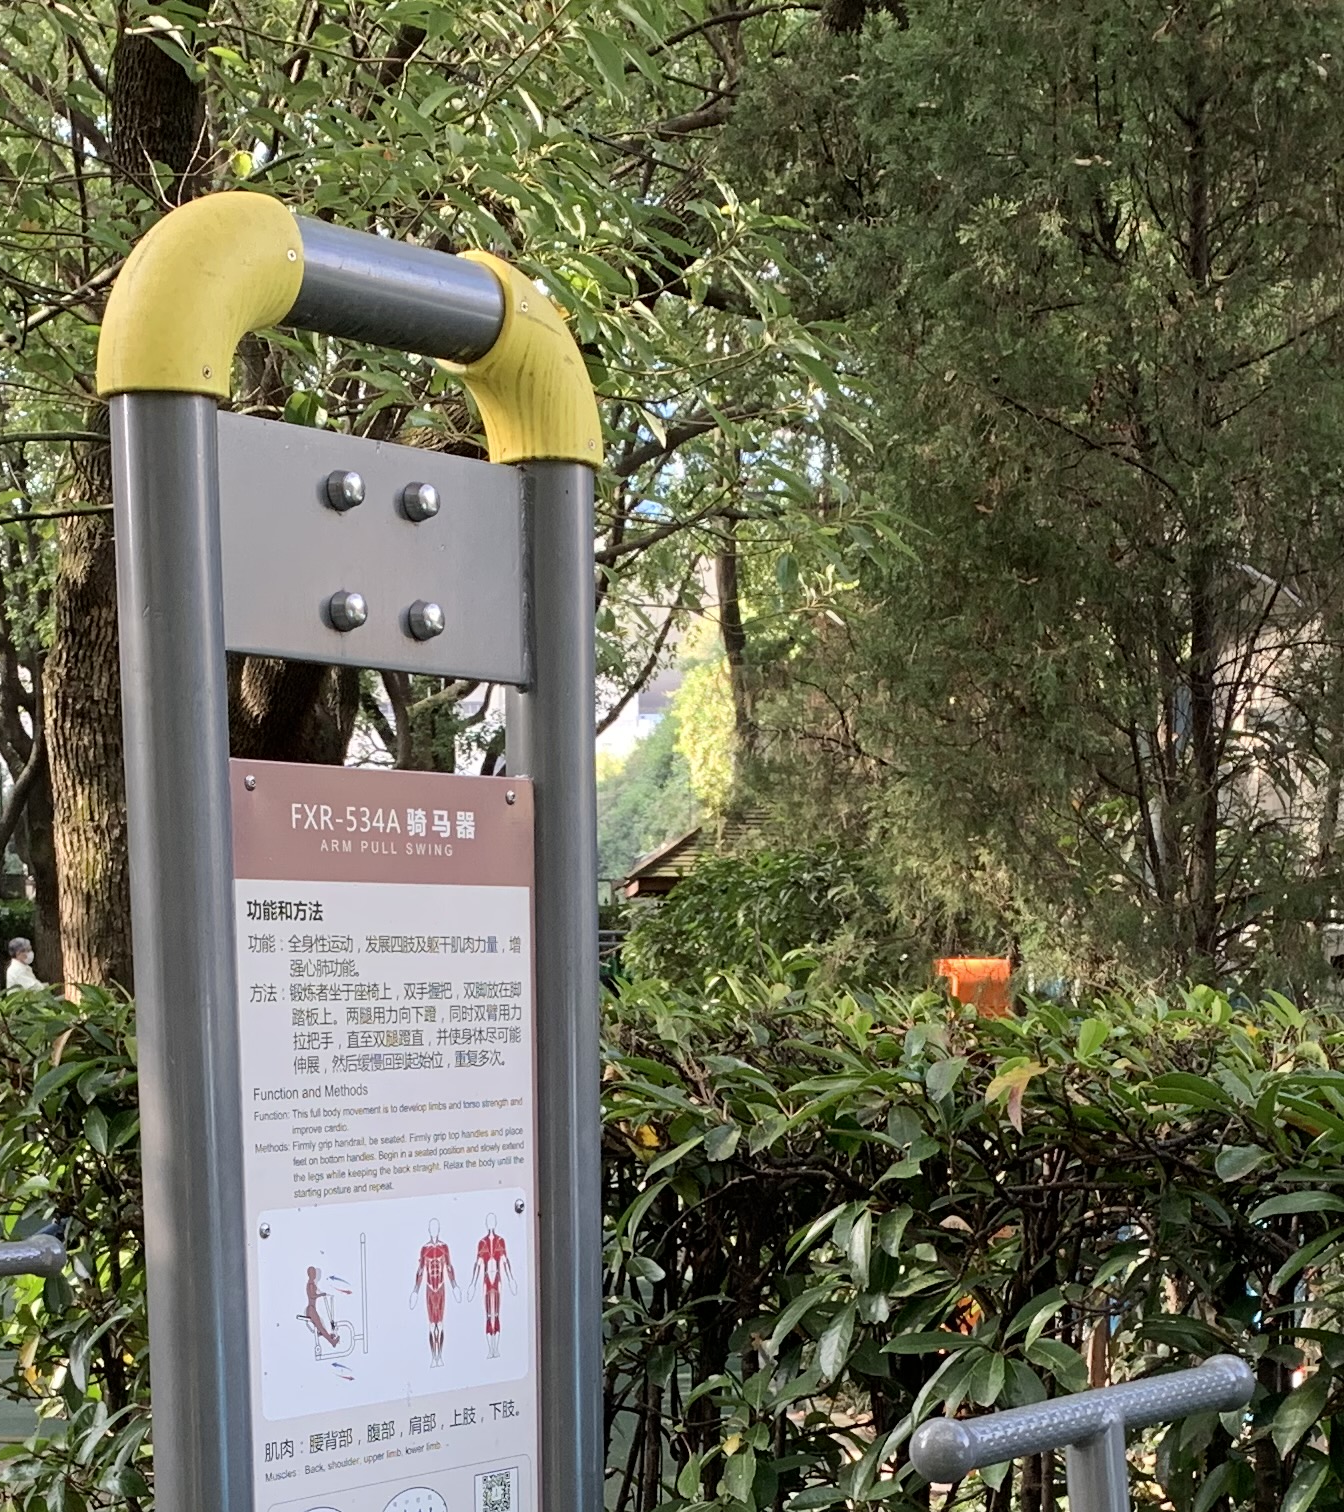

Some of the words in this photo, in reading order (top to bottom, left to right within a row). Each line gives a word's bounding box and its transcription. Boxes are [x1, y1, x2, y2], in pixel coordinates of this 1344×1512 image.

[291, 802, 401, 834] FXR-534A
[406, 807, 475, 839] 骑马器
[319, 838, 352, 852] ARM
[360, 839, 397, 854] PULL
[405, 841, 453, 856] SWING
[246, 898, 323, 922] 功能和方法
[253, 1086, 299, 1101] Function
[301, 1084, 321, 1099] and
[324, 1082, 368, 1097] Methods
